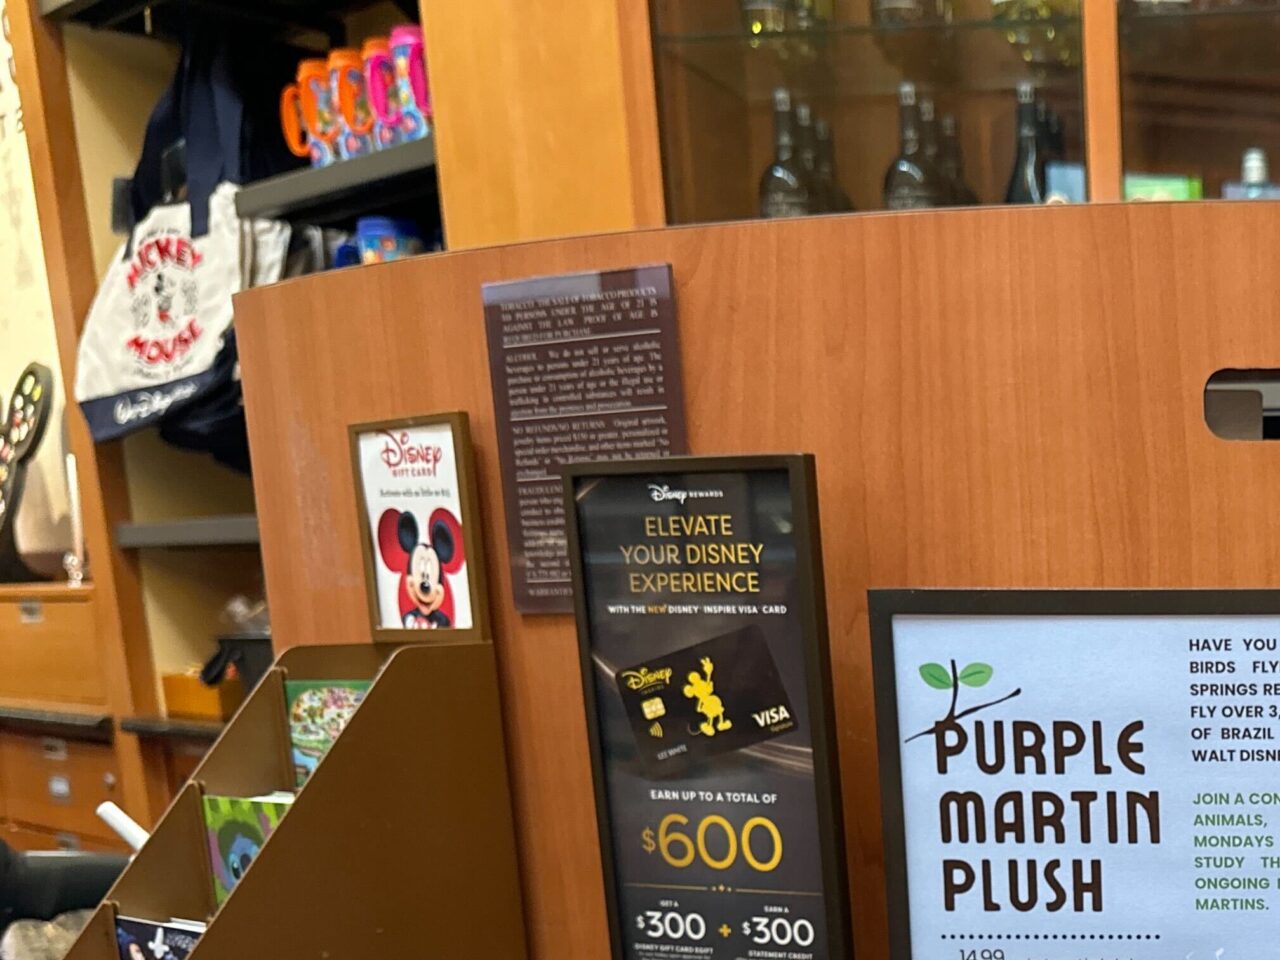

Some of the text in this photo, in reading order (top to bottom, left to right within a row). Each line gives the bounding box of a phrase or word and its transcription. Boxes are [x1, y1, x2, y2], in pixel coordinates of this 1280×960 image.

[377, 431, 442, 477] Disney
[392, 467, 432, 477] GIFT CARD
[648, 484, 687, 504] Disney
[644, 515, 733, 536] ELEVATE
[620, 543, 763, 565] YOUR DISNEY
[629, 572, 760, 593] EXPERIENCE
[607, 605, 629, 614] WITH
[631, 605, 646, 614] THE
[703, 605, 736, 614] INSPIRE
[762, 605, 787, 614] CARD
[1189, 638, 1232, 652] HAVE
[1242, 638, 1277, 651] YOU
[1189, 661, 1236, 674] BIRDS
[622, 667, 672, 690] Disney
[1189, 683, 1258, 696] SPRINGS
[752, 705, 790, 727] VISA
[1190, 705, 1217, 719] FLY
[1221, 705, 1264, 718] OVER
[1190, 727, 1212, 740] OF
[1220, 727, 1275, 740] BRAZIL
[934, 719, 1146, 775] PURPLE
[1191, 749, 1237, 762] WALT
[650, 789, 777, 803] EARN UP TO A TOTAL OF
[1192, 792, 1230, 805] JOIN
[1234, 792, 1245, 805] A
[939, 790, 1161, 845] MARTIN
[1193, 813, 1268, 828] ANIMALS,
[642, 813, 783, 872] $600
[1194, 835, 1275, 848] MONDAYS
[1194, 856, 1245, 869] STUDY
[942, 858, 1103, 913] PLUSH
[1194, 877, 1271, 890] ONGOING
[1195, 898, 1270, 911] MARTINS.
[636, 911, 706, 940] $300
[741, 916, 815, 946] $300
